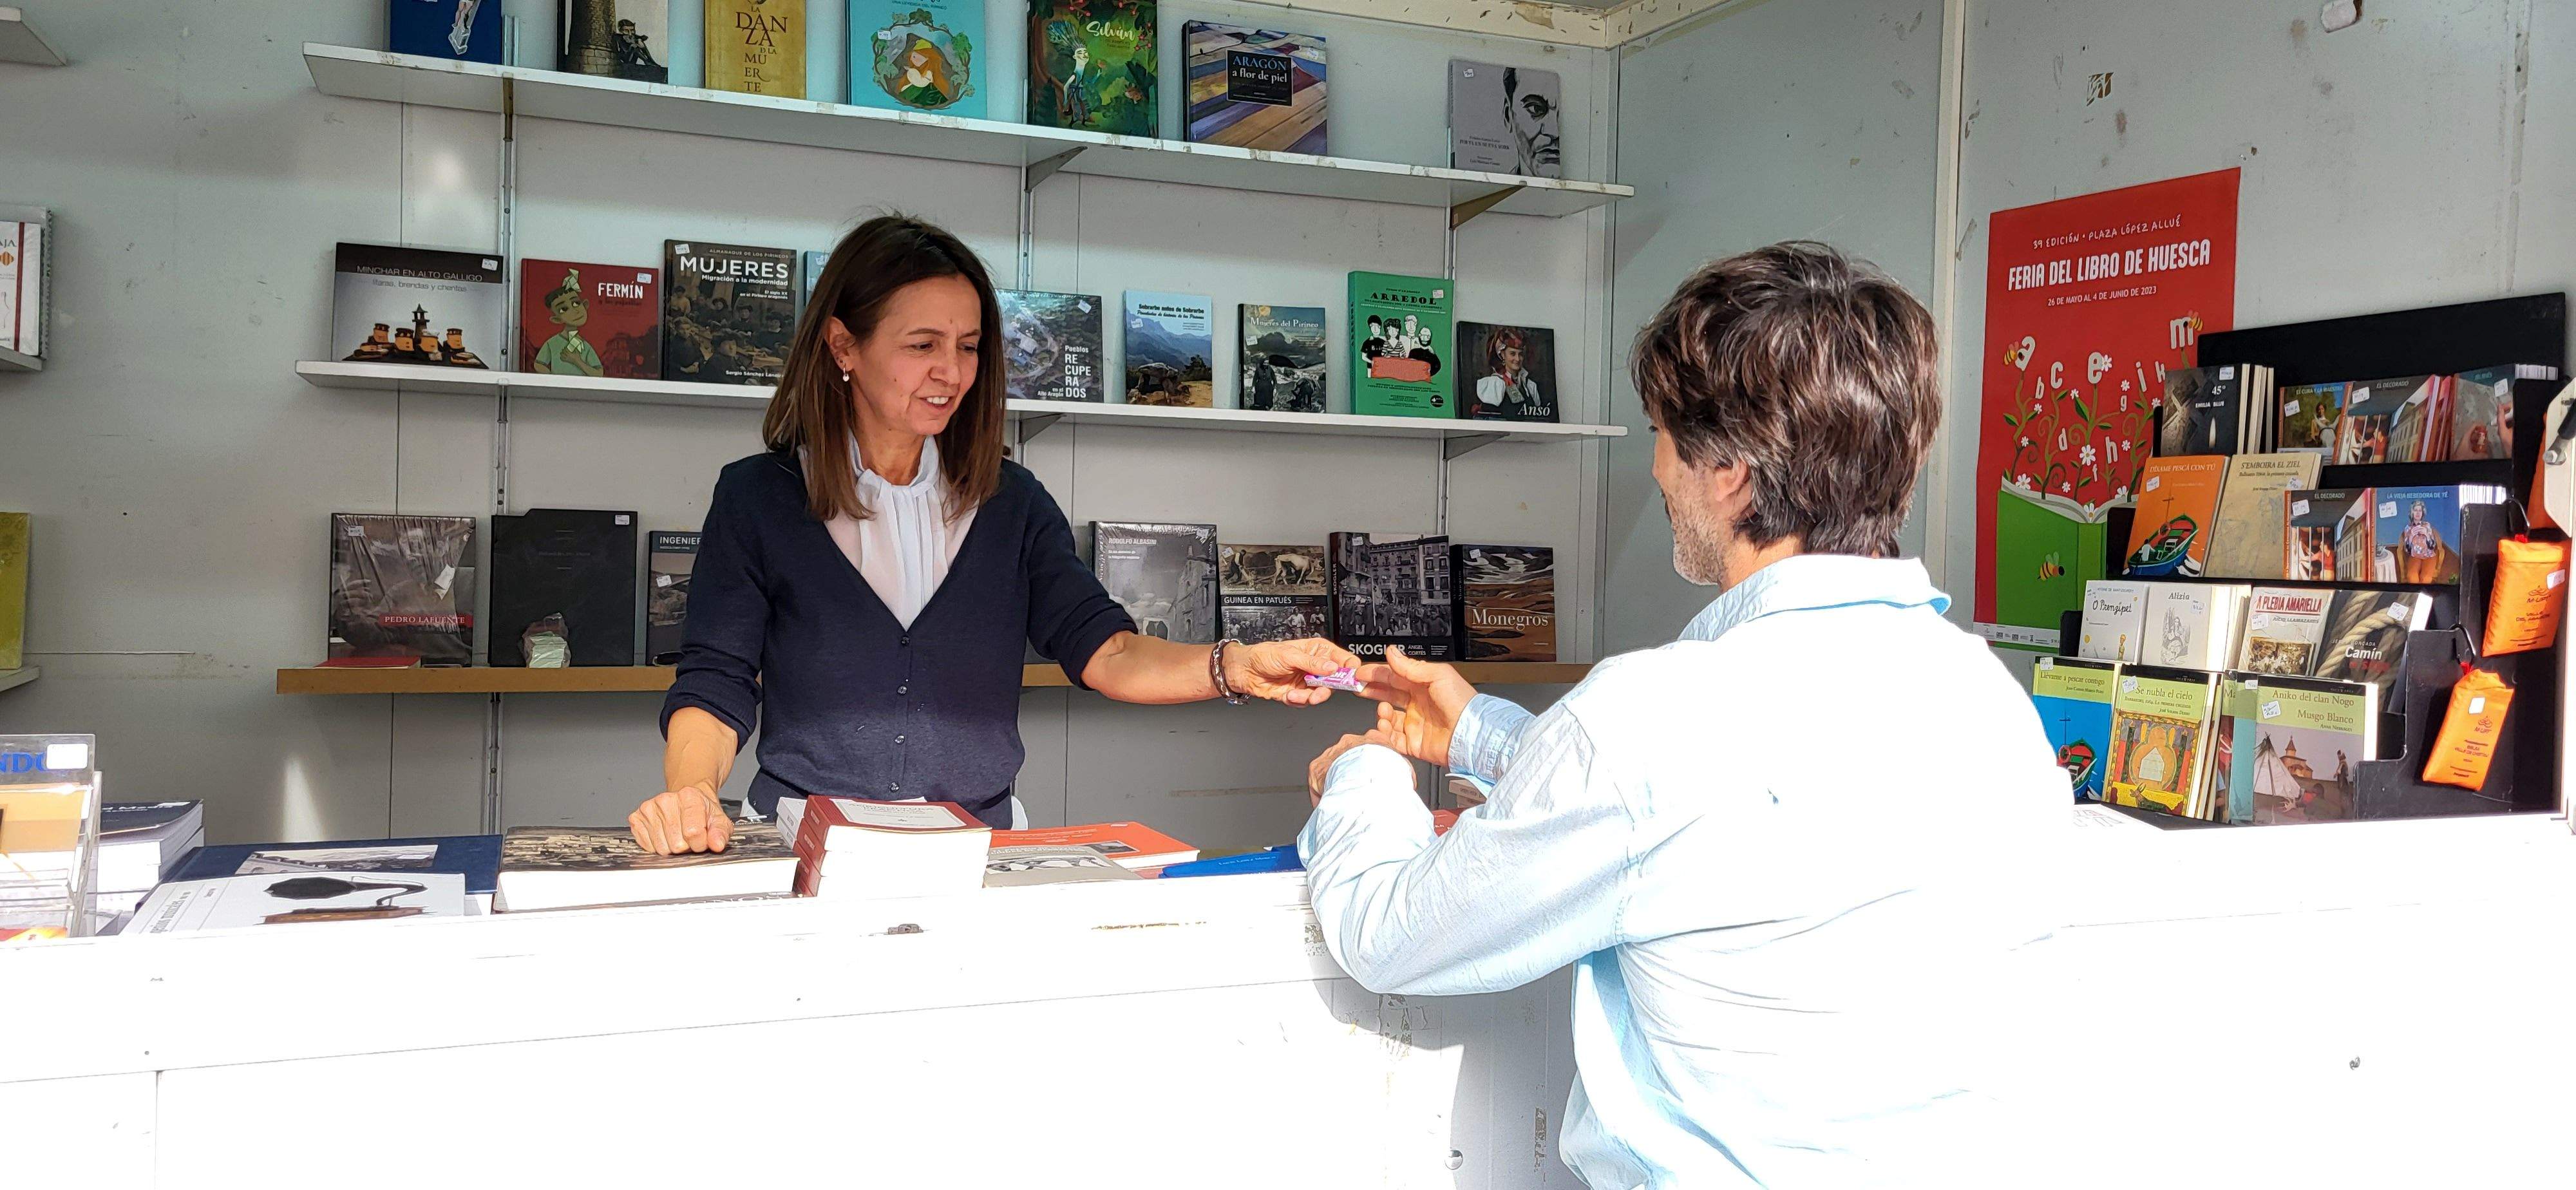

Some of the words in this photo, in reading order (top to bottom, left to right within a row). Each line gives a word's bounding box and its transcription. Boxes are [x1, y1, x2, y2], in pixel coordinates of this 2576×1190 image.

[744, 53, 767, 64] MU
[1233, 55, 1287, 71] ARAGÓN
[744, 67, 772, 82] ER
[1240, 68, 1256, 79] flor
[1258, 70, 1269, 80] de
[1271, 73, 1287, 84] piel
[744, 81, 762, 93] TE
[2032, 240, 2043, 250] 39
[2046, 232, 2079, 248] EDICIÓN
[2088, 229, 2117, 241] PLAZA
[2121, 223, 2148, 235] LÓPEZ
[2151, 214, 2181, 232] ALLUÉ
[680, 256, 789, 279] MUJERES
[2008, 263, 2045, 291] FERIA
[2049, 259, 2072, 287] DEL
[2077, 252, 2119, 281] LIBRO
[2124, 247, 2143, 276] DE
[2148, 238, 2211, 272] HUESCA
[357, 266, 400, 276] MINCHAR
[418, 270, 440, 279] ALTO
[443, 272, 482, 282] GALLIGO
[701, 274, 734, 283] Migración
[598, 280, 643, 299] FERMÍN
[2048, 297, 2055, 307] 26
[2056, 296, 2065, 305] DE
[2065, 294, 2083, 305] MAYO
[2083, 293, 2092, 302] AL
[2092, 292, 2098, 301] 4
[2099, 292, 2108, 300] DE
[2109, 288, 2129, 299] JUNIO
[2130, 288, 2140, 297] DE
[2141, 286, 2157, 296] 2023
[1370, 292, 1437, 305] ARREDOL
[1251, 317, 1279, 327] Mujeres
[1293, 319, 1319, 328] Pirineo
[1065, 345, 1089, 354] Pueblos
[1065, 354, 1078, 364] RE
[1065, 365, 1092, 376] CUPE
[1065, 376, 1079, 386] RA
[1065, 388, 1086, 399] DOS
[1517, 402, 1551, 417] Ansó
[1265, 596, 1292, 604] PATUÉS
[2092, 600, 2098, 610] O
[1472, 609, 1548, 631] Monegros
[2345, 645, 2383, 660] Camín
[2136, 685, 2145, 695] Se
[2146, 687, 2166, 697] nubla
[2168, 689, 2174, 699] el
[2175, 690, 2193, 701] cielo
[2272, 690, 2297, 700] Aniko
[2299, 692, 2311, 701] del
[2313, 693, 2329, 703] clan
[2331, 695, 2354, 708] Nogo
[2298, 709, 2324, 722] Musgo
[2327, 712, 2354, 724] Blanco
